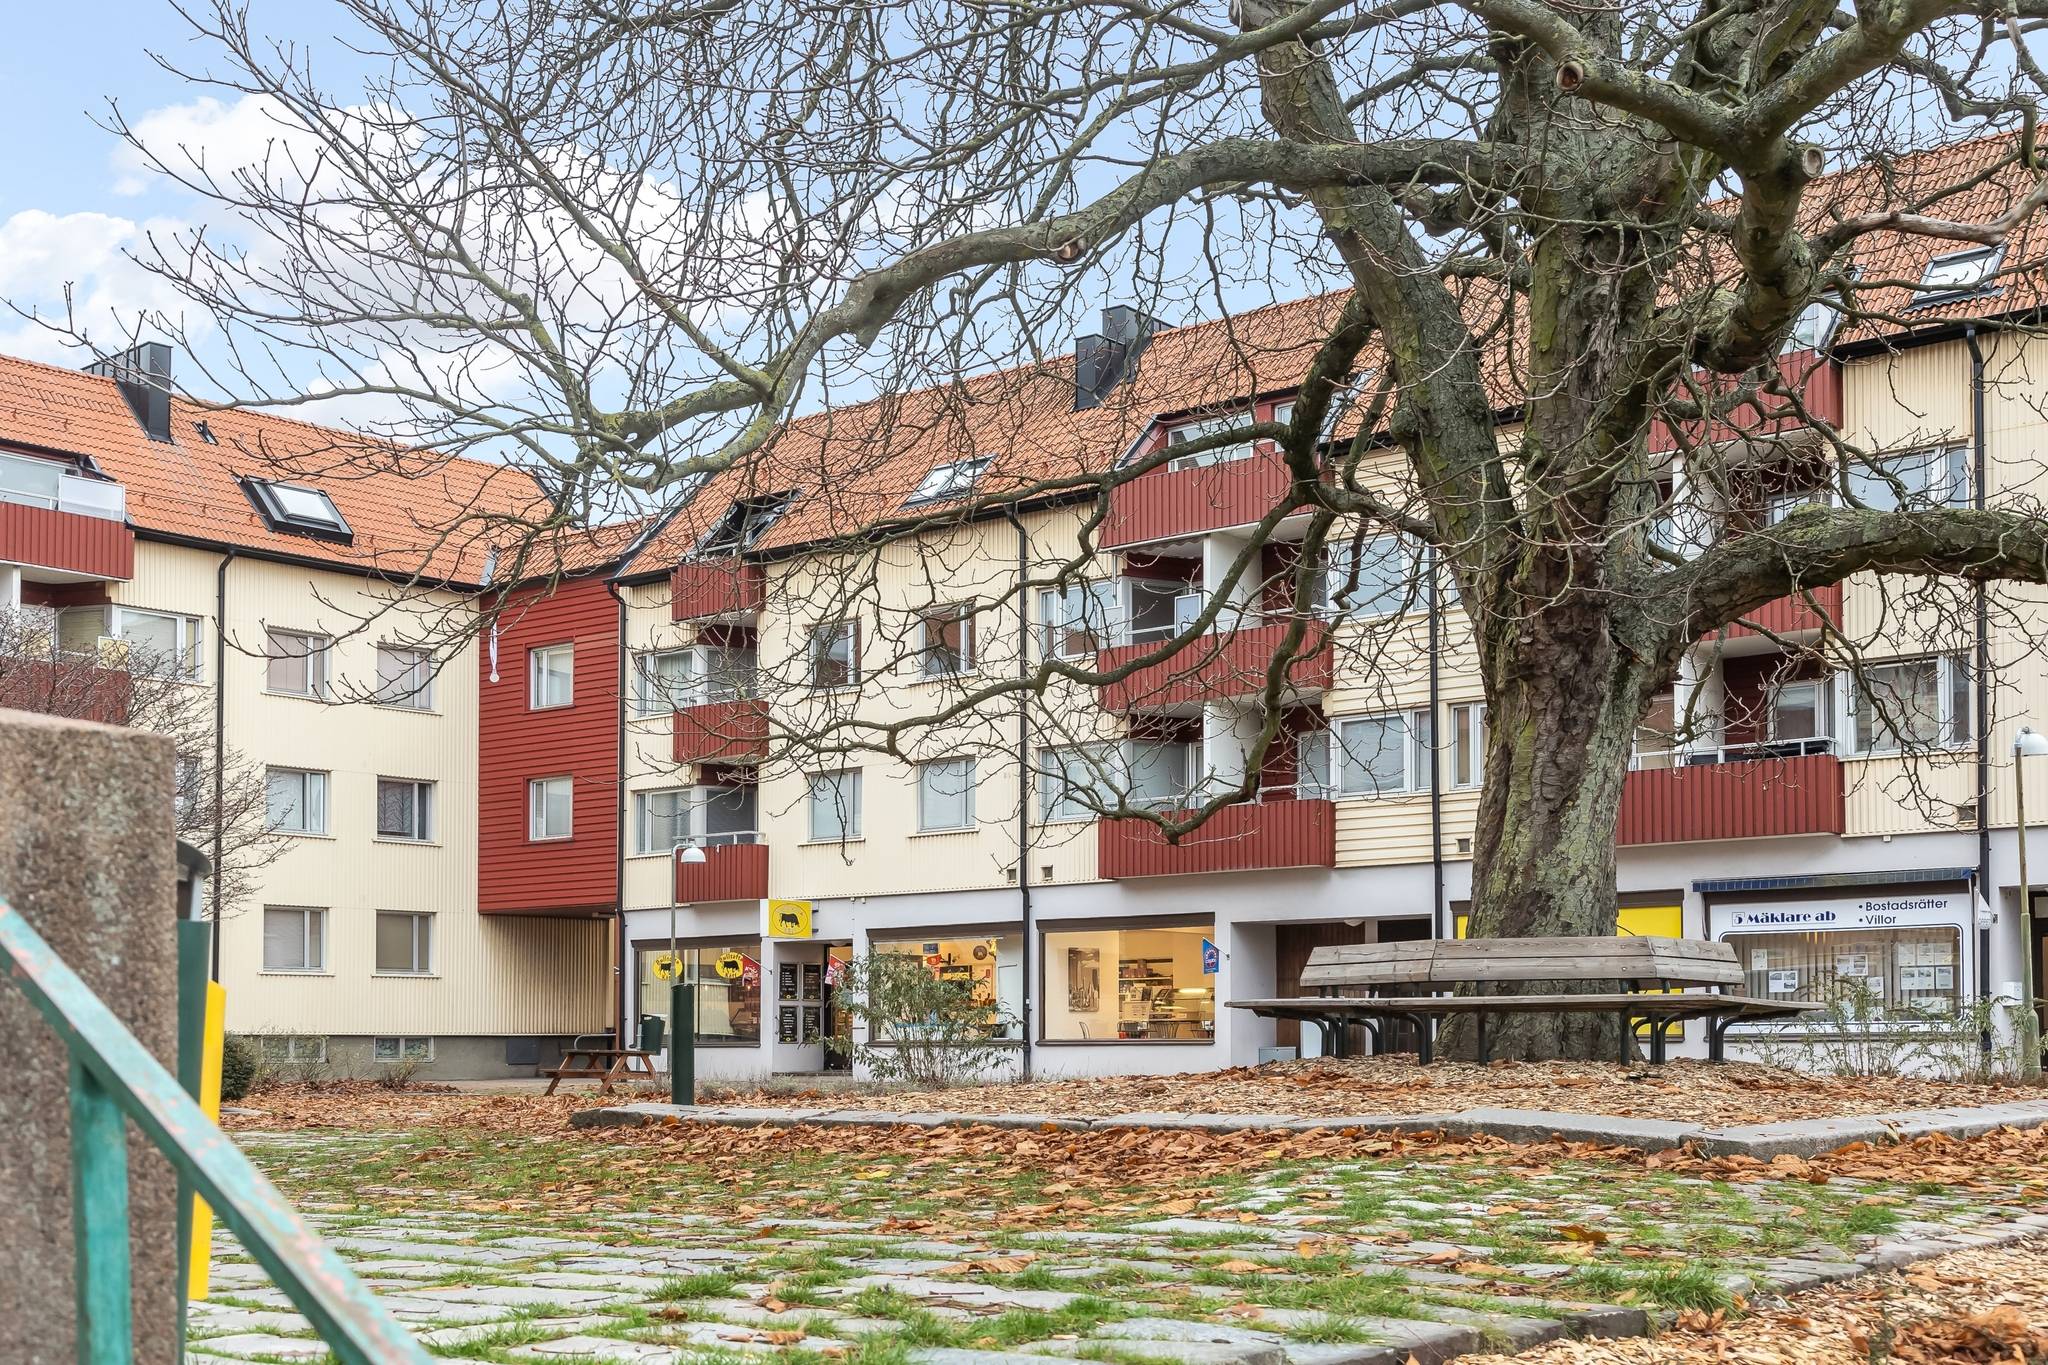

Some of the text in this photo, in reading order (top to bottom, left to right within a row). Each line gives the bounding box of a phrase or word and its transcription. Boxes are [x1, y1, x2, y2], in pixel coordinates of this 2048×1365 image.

[1866, 899, 1948, 911] Bostadsrätter
[1747, 912, 1811, 924] Mäklare
[1815, 910, 1836, 922] ab
[1866, 914, 1897, 925] Villor
